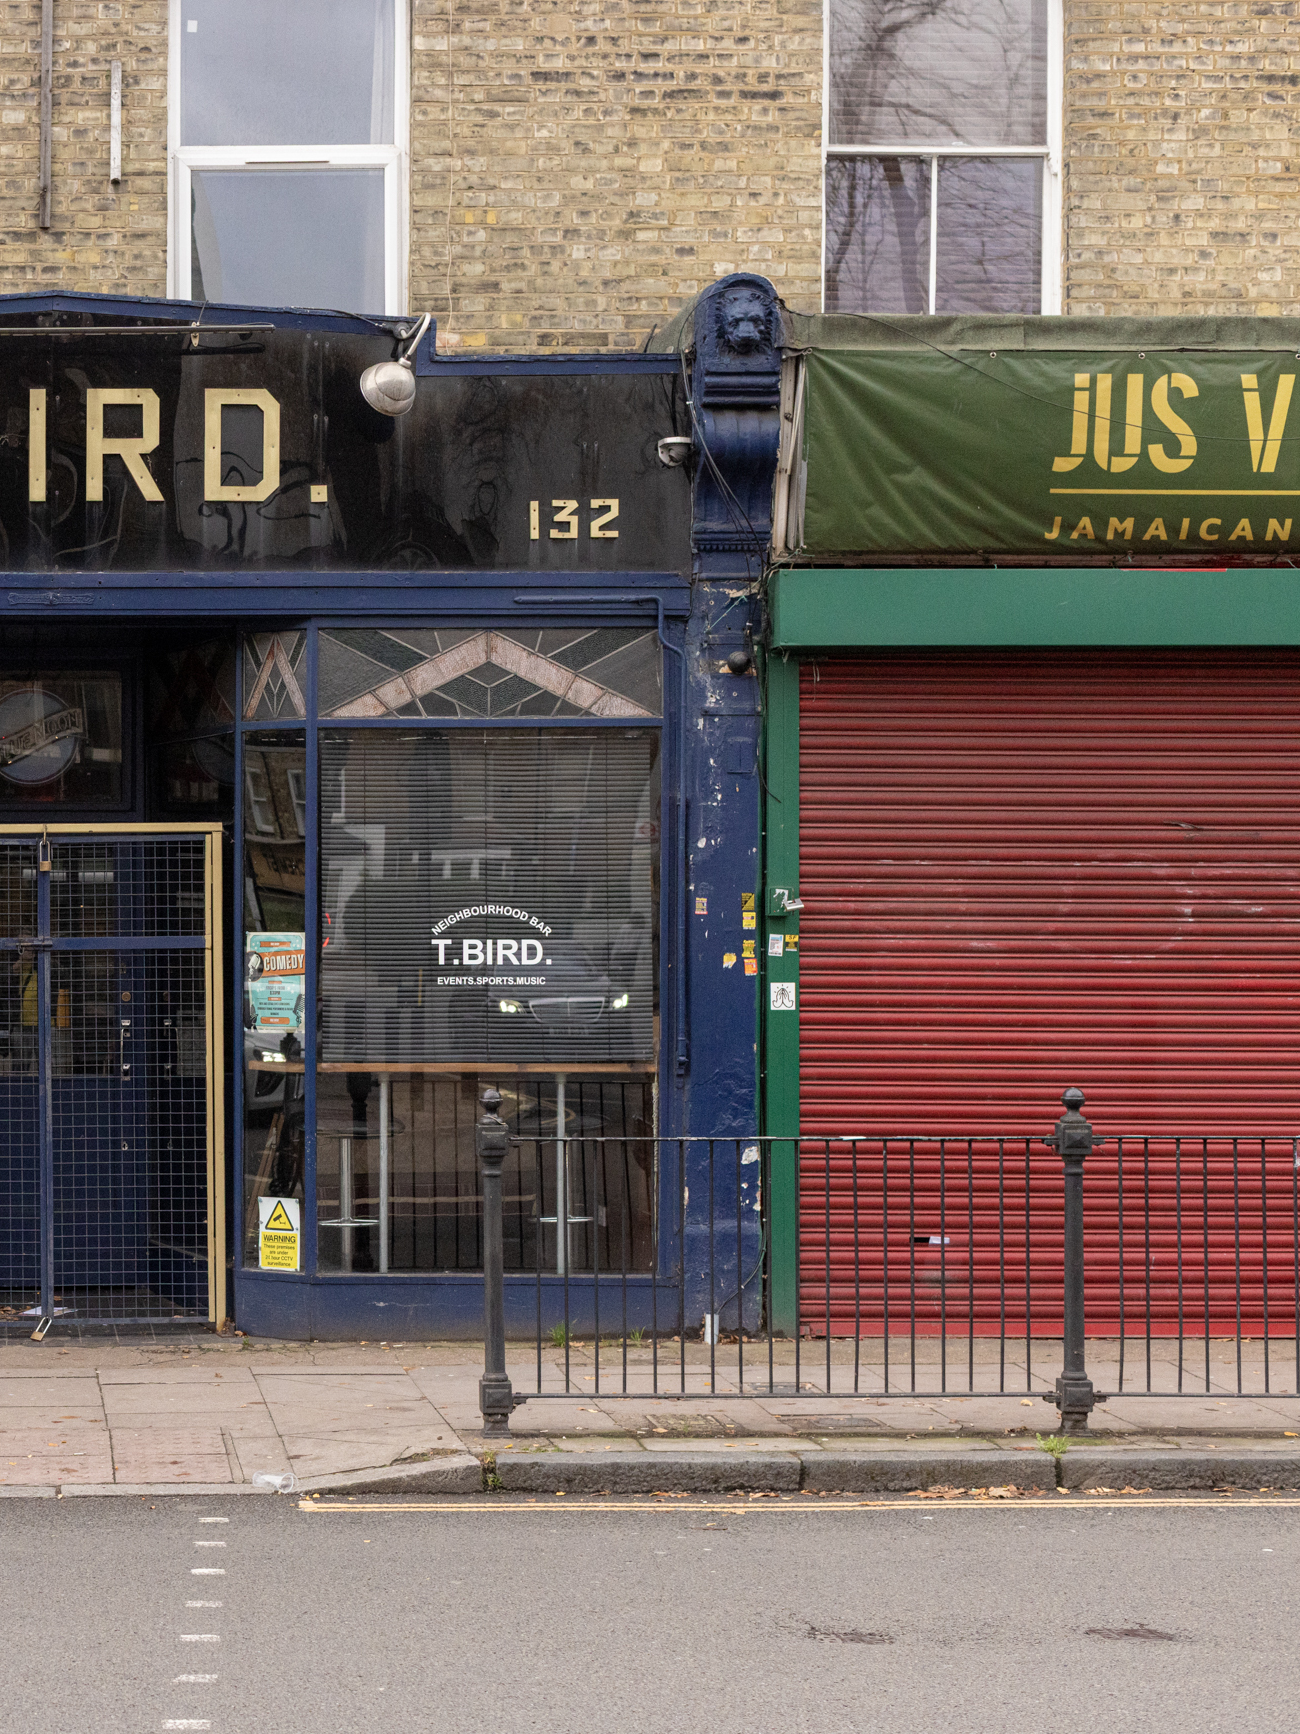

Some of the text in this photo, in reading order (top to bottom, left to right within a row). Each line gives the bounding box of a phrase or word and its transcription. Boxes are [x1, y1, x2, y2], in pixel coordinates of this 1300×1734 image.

[1052, 372, 1199, 474] JUS
[528, 498, 619, 540] 132
[1044, 516, 1293, 541] JAMAICAN
[431, 905, 552, 937] NEIGHBOURHOOD BAR
[263, 954, 305, 971] COMEDY
[431, 939, 552, 965] T.BIRD.
[263, 1234, 296, 1243] WARNING
